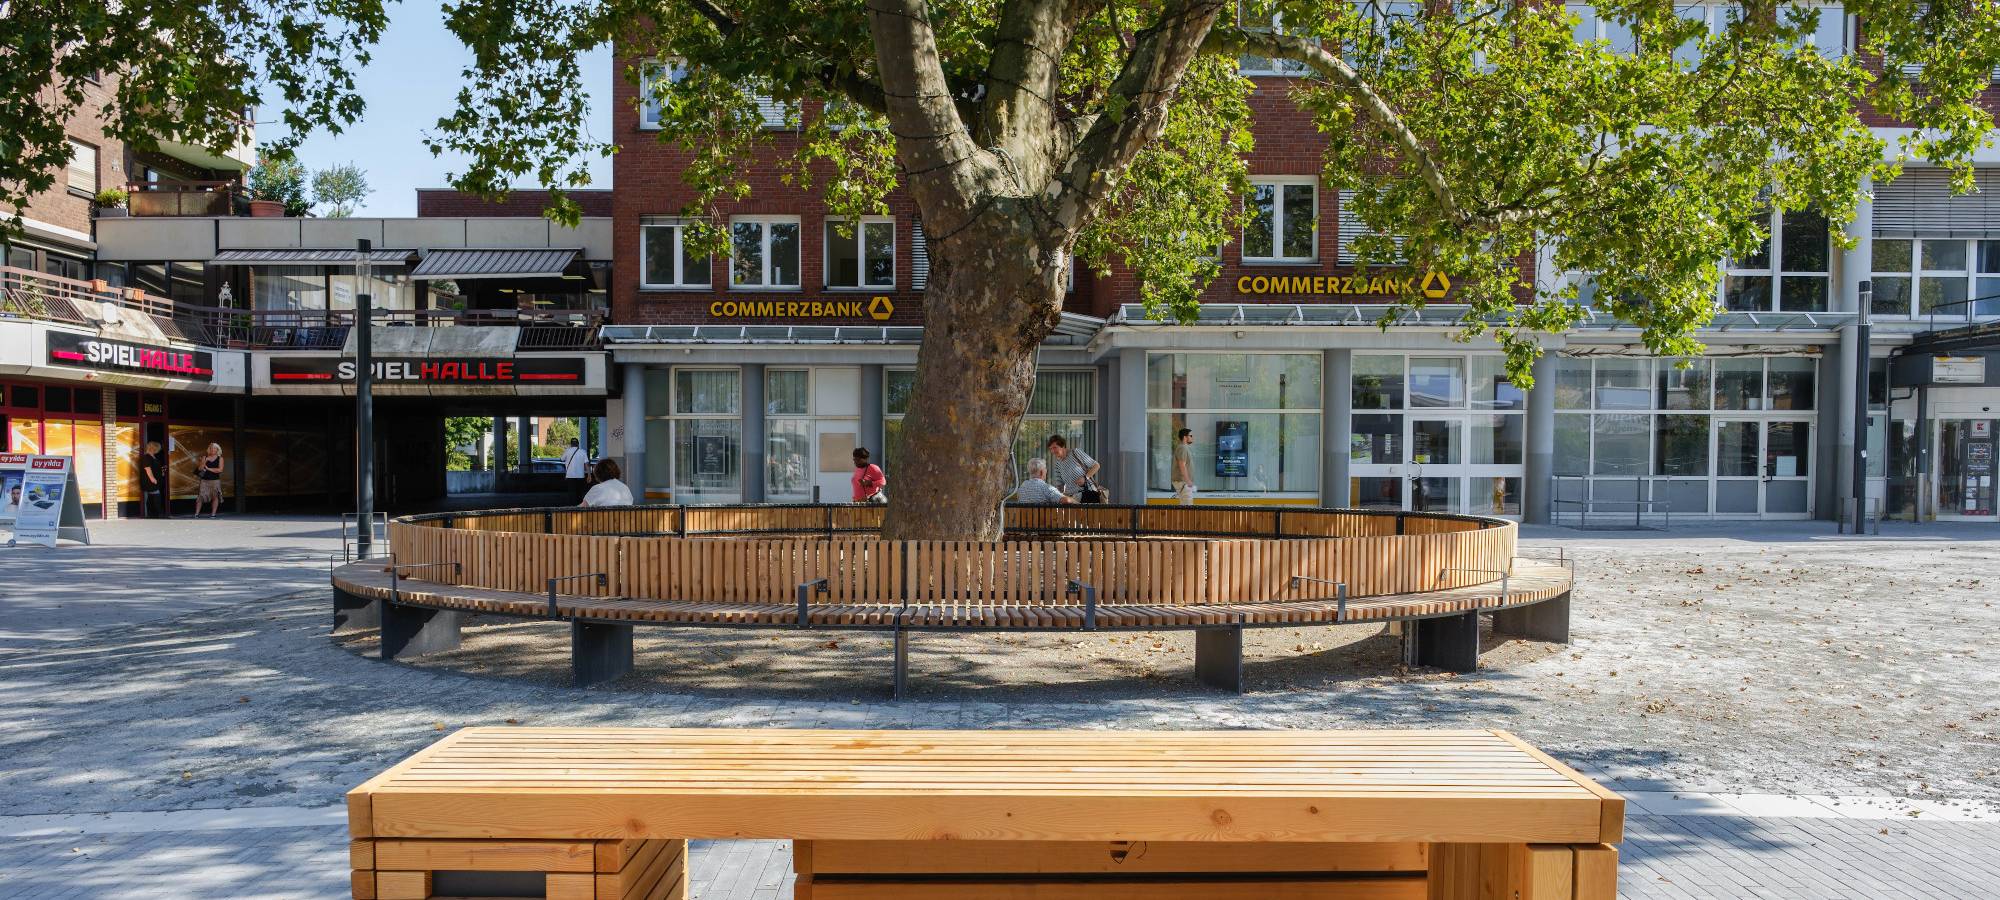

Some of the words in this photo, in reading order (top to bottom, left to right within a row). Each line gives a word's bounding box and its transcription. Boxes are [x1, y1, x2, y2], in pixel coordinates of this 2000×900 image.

[710, 301, 864, 317] COMMERZBANK
[87, 341, 194, 373] SPIELHALLE
[338, 362, 514, 380] SIELHALLE
